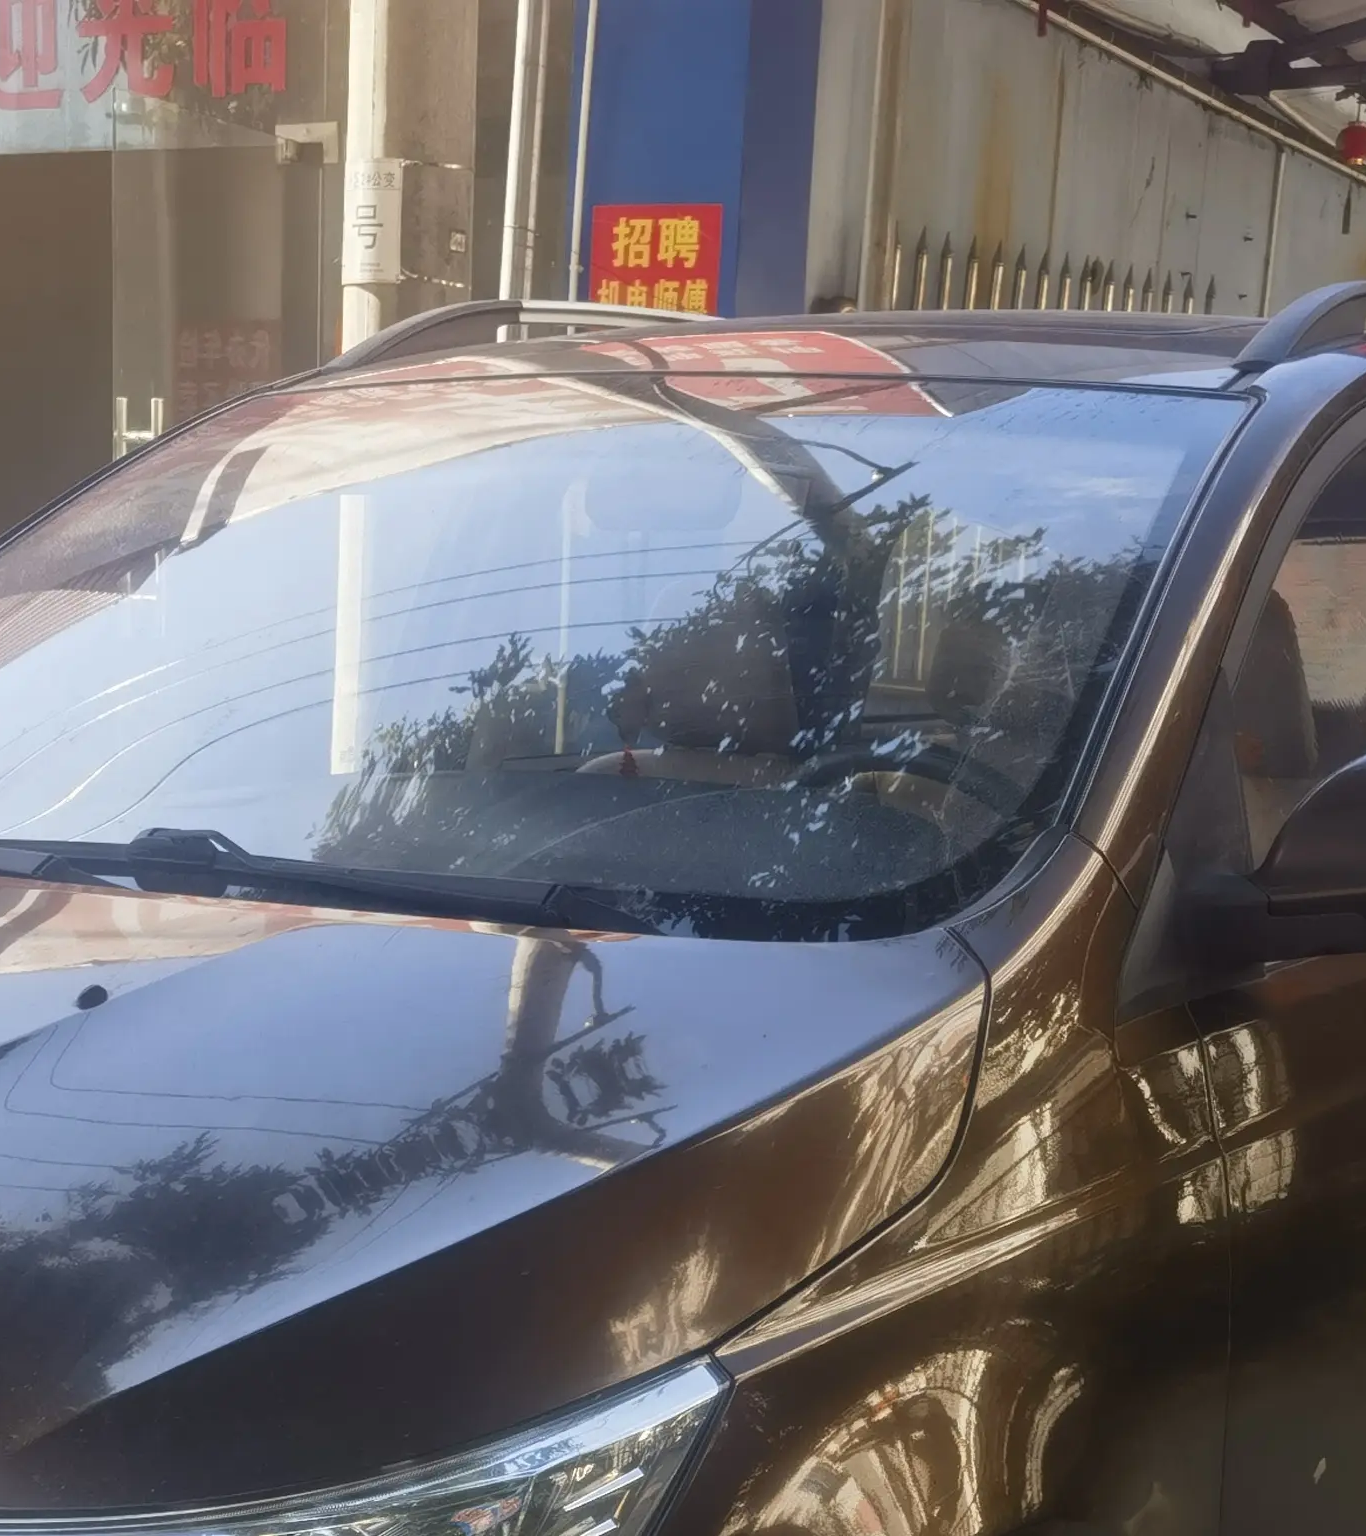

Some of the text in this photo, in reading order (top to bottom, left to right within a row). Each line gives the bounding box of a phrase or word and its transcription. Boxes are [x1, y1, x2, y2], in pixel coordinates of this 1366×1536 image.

[352, 204, 383, 249] 号
[611, 216, 701, 268] 招聘
[597, 279, 708, 315] 机电师傅
